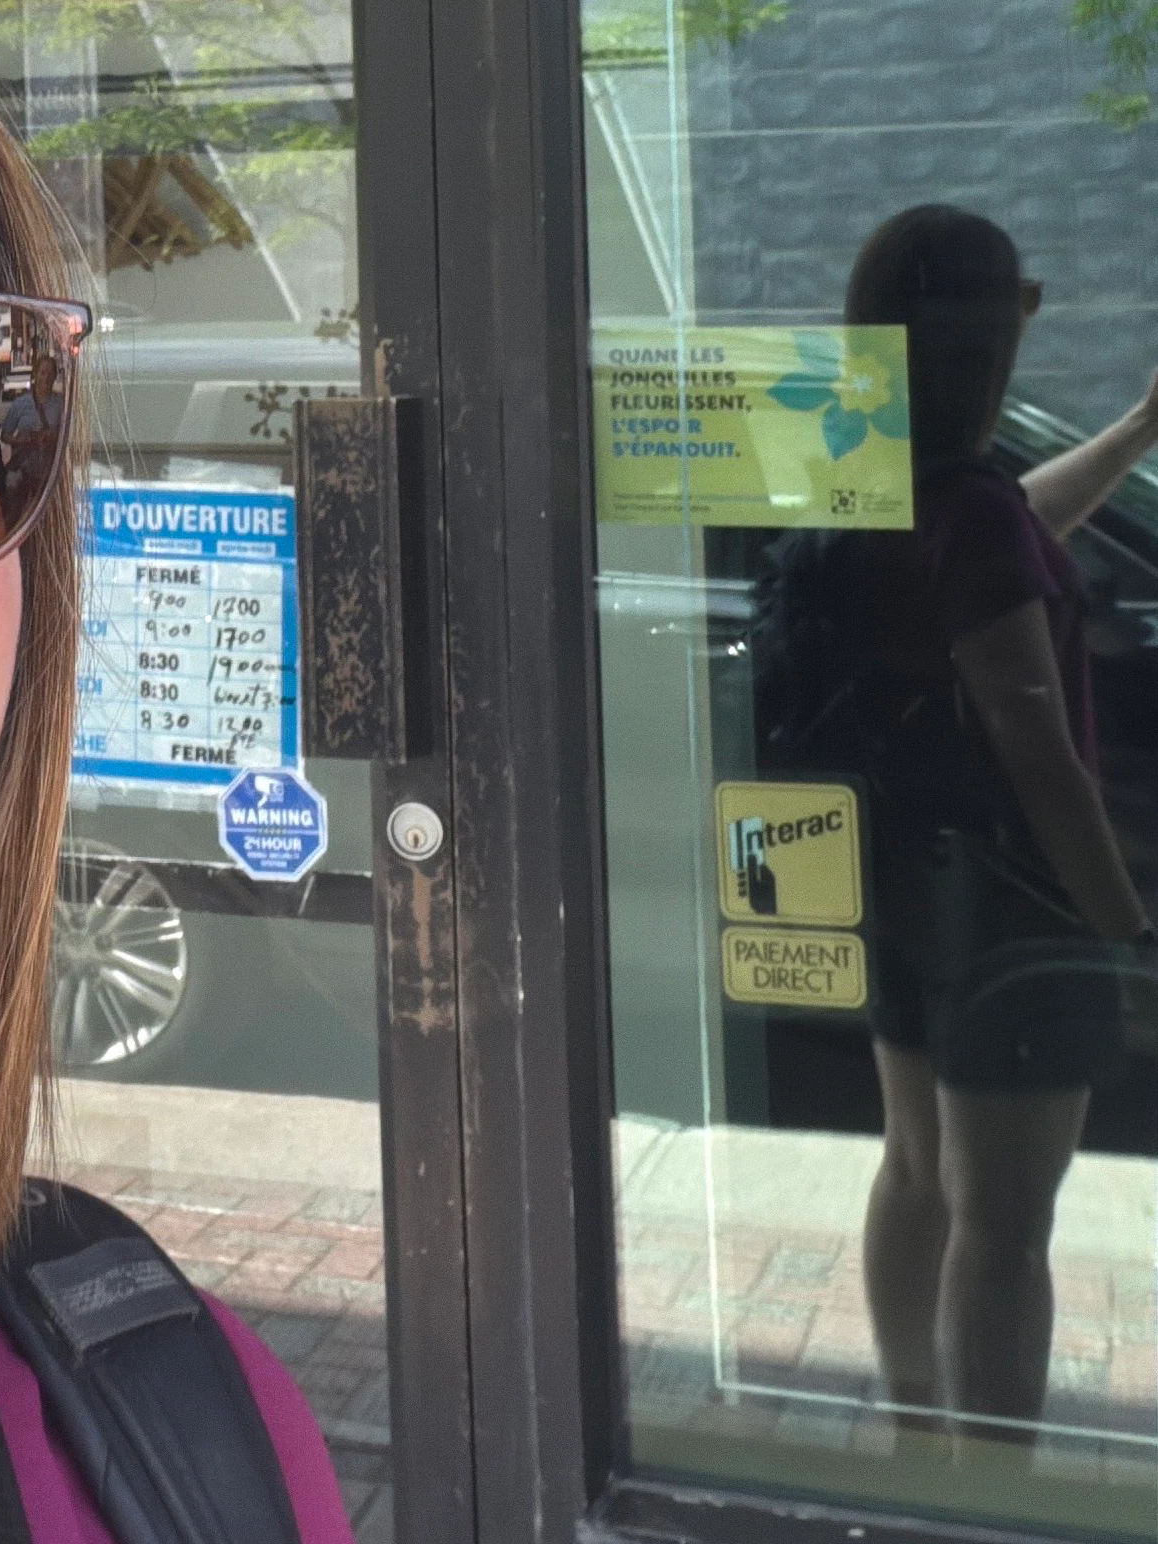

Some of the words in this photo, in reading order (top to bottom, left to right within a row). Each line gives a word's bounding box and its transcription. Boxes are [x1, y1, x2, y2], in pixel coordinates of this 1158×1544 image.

[690, 347, 725, 363] LES
[612, 418, 703, 433] L'ESPOR
[102, 501, 288, 536] D'OUVERTURE
[136, 565, 201, 585] FERMÉ
[139, 653, 179, 671] 8:30
[140, 681, 179, 701] 8:30
[230, 807, 314, 827] WARNING
[262, 837, 302, 851] HOUR
[736, 809, 843, 868] Interac
[734, 939, 852, 969] PAIEMENT
[753, 966, 835, 993] DIRECT
